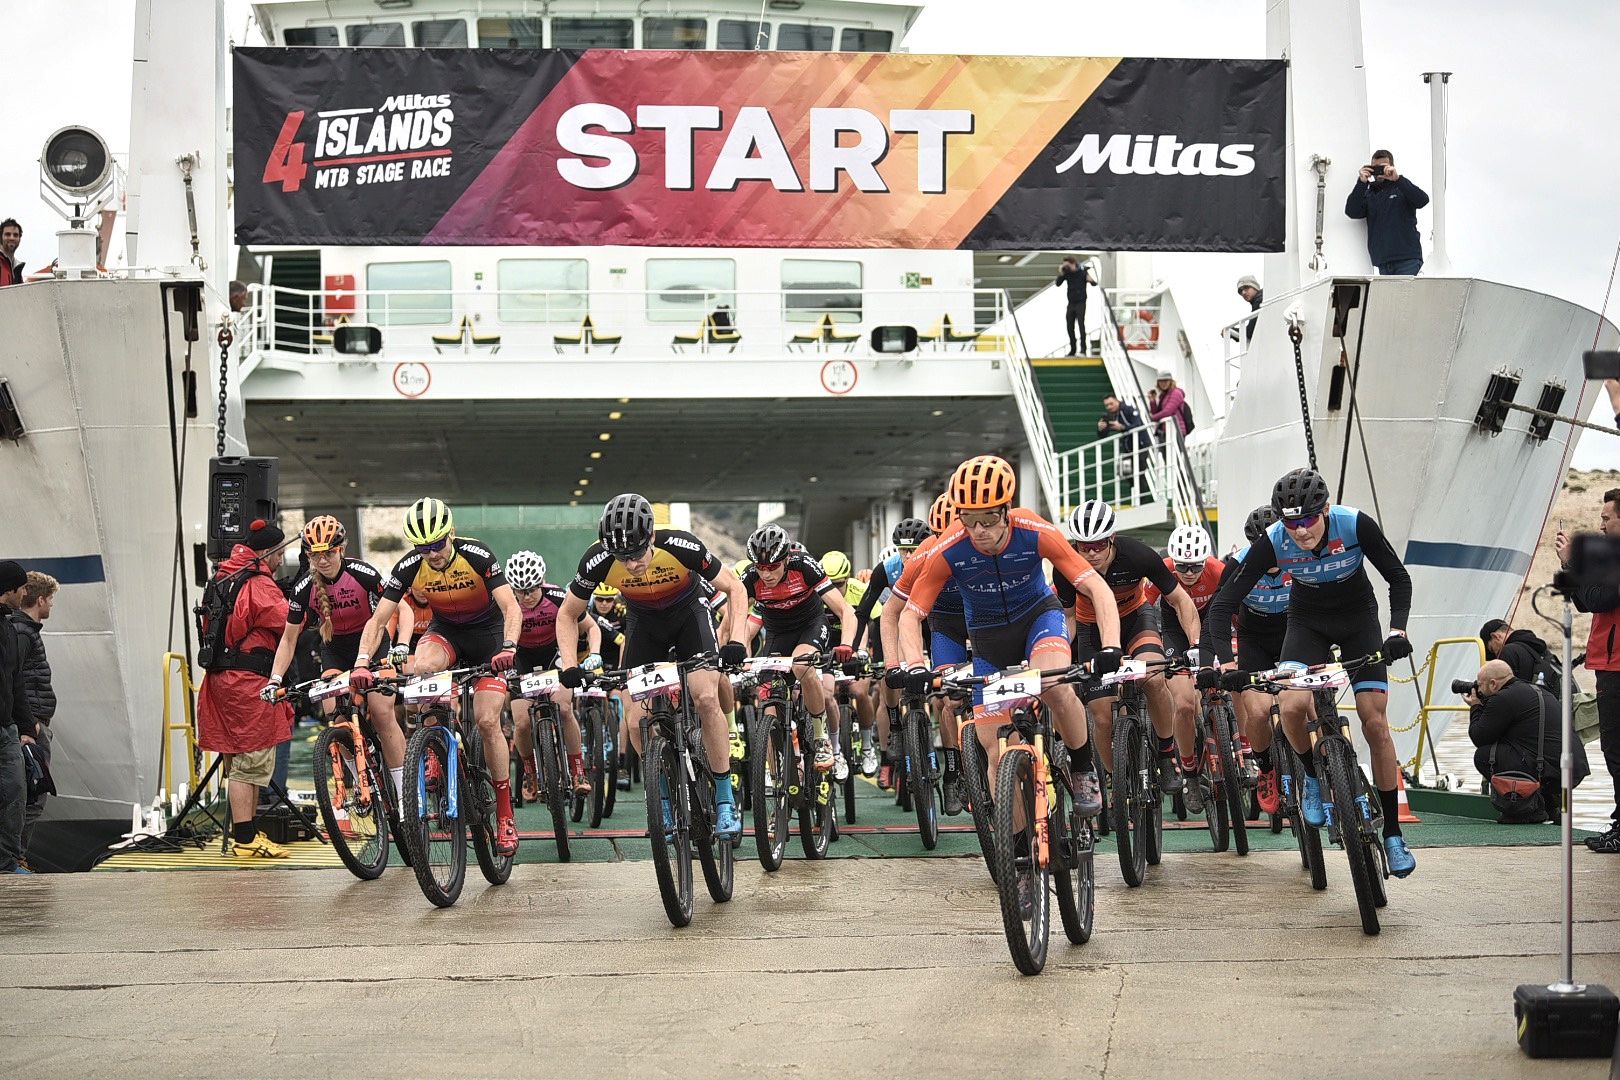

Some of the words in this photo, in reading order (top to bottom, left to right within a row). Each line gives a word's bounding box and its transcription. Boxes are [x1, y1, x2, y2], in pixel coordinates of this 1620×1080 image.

[379, 93, 452, 112] Mitas
[262, 110, 308, 192] 4
[314, 108, 454, 158] ISLANDS
[555, 102, 974, 194] START
[1055, 133, 1256, 176] Mitas
[315, 168, 349, 189] MTB
[356, 162, 405, 185] STAGE
[411, 157, 452, 179] RACE
[459, 543, 491, 559] Mitas
[664, 536, 701, 552] Mitas
[346, 562, 377, 577] Mitas
[1287, 555, 1356, 575] CUBE
[1246, 593, 1290, 603] CUB
[417, 683, 438, 693] 1-B
[640, 673, 665, 687] 1-A
[996, 682, 1025, 695] 4-B
